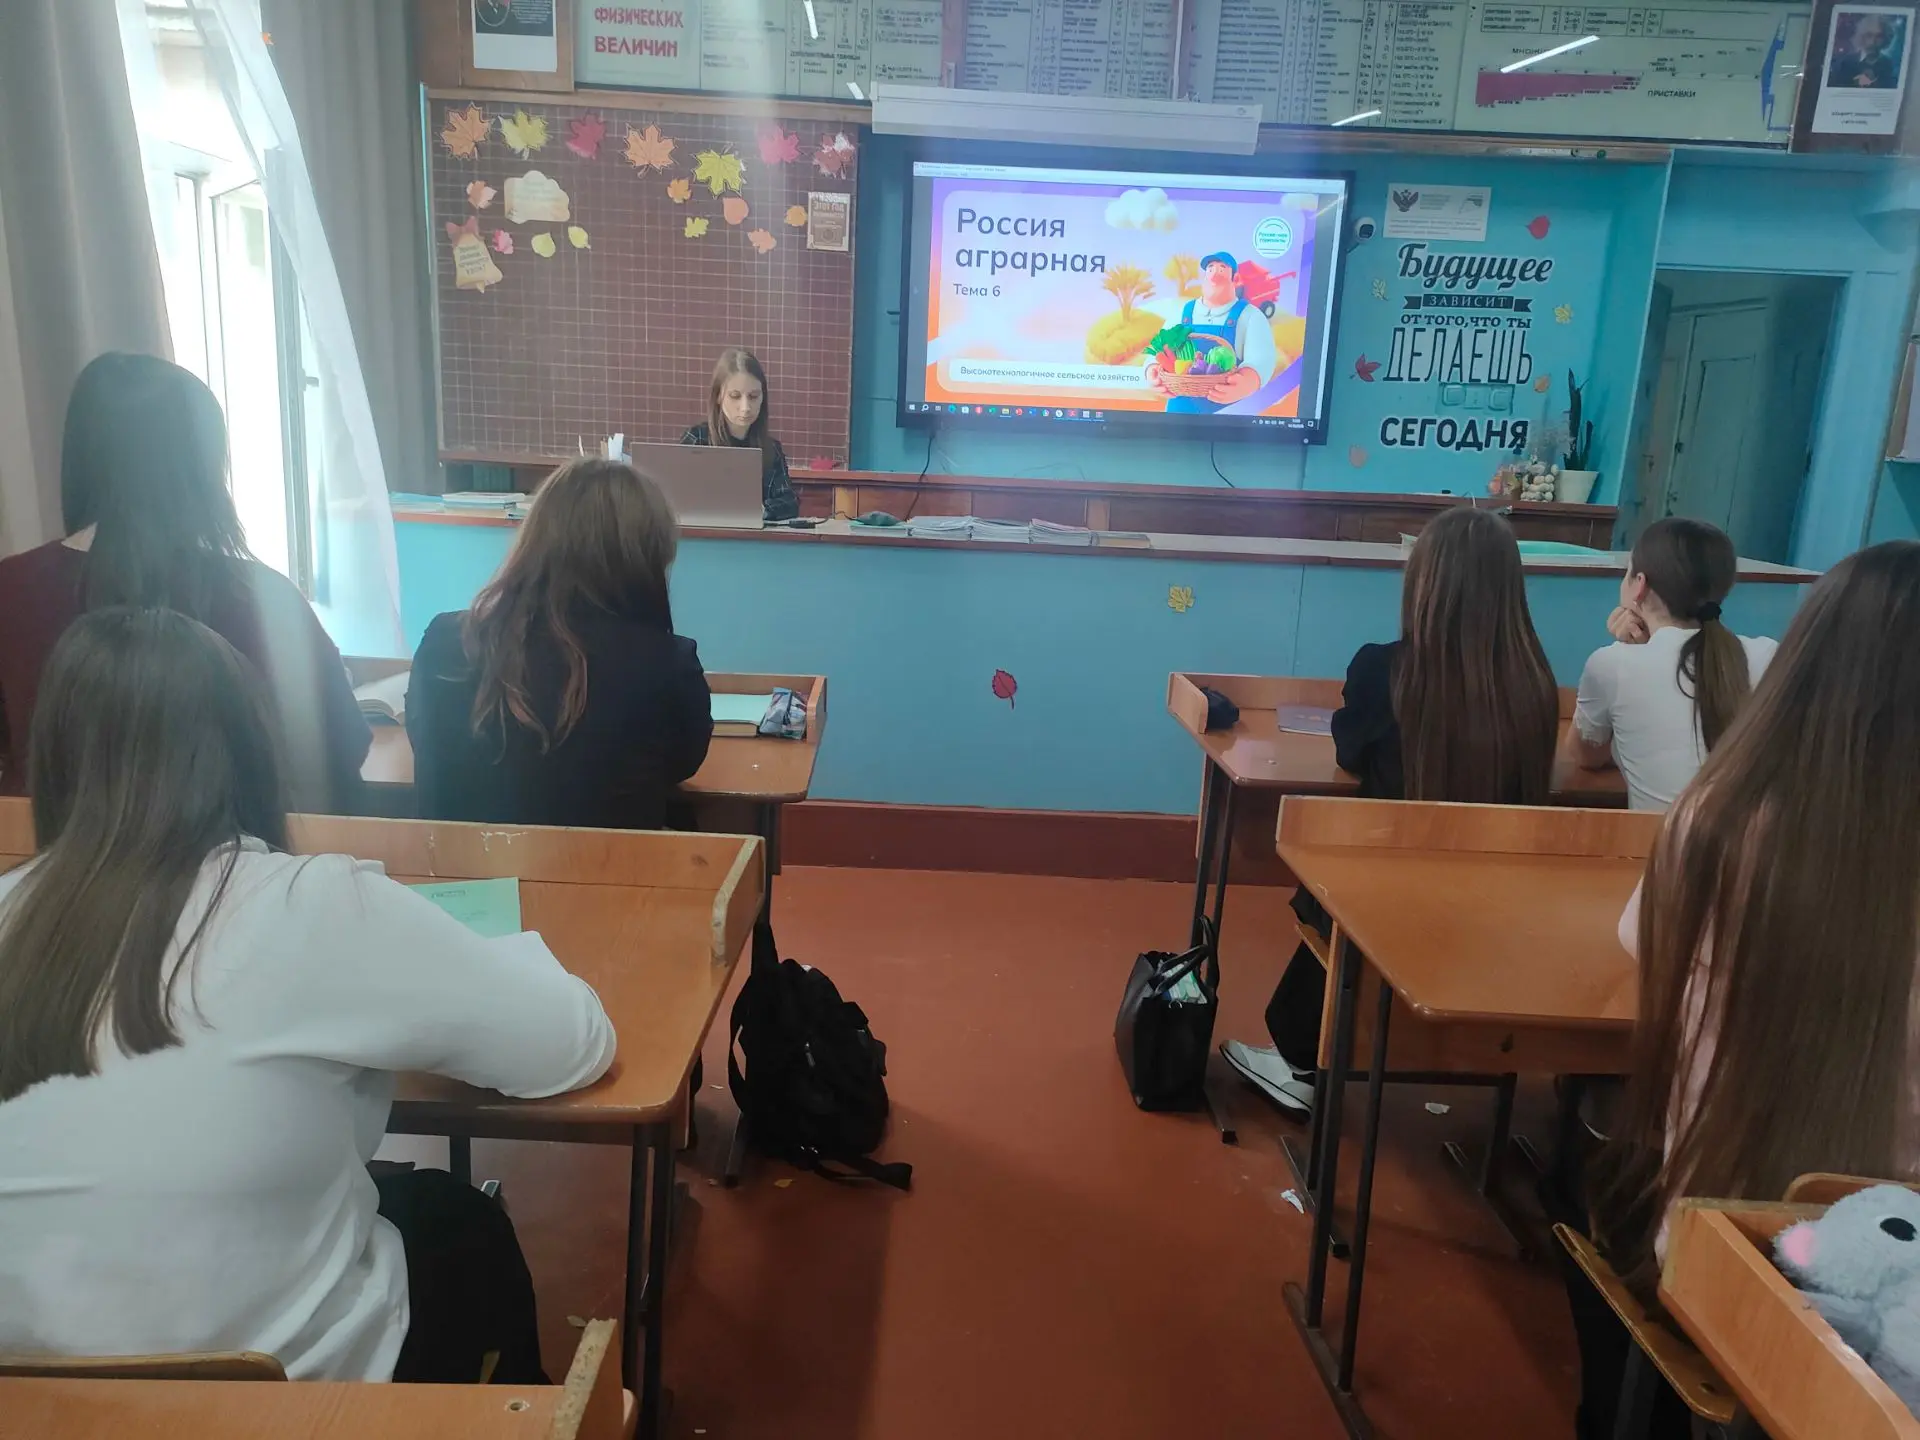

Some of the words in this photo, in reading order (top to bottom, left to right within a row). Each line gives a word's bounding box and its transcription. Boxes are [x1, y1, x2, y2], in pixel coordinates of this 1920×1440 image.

[594, 7, 684, 28] ФИЗИЧЕСКИХ
[594, 36, 678, 57] ВЕЛИЧИН
[1647, 90, 1697, 98] ПРИСТАВКИ
[957, 207, 1065, 238] Россия
[955, 248, 1106, 277] аграрная
[1398, 243, 1553, 290] Будущее
[953, 283, 988, 297] Тема
[992, 285, 1001, 297] 6
[1428, 295, 1509, 308] ЗАВИСИТ
[1383, 327, 1534, 385] ДЕЛАЕШЬ
[960, 366, 1055, 379] Высокотехнологичное
[1056, 372, 1096, 381] сельское
[1097, 373, 1141, 383] хозяйство
[1380, 416, 1530, 452] СЕГОДНЯ
